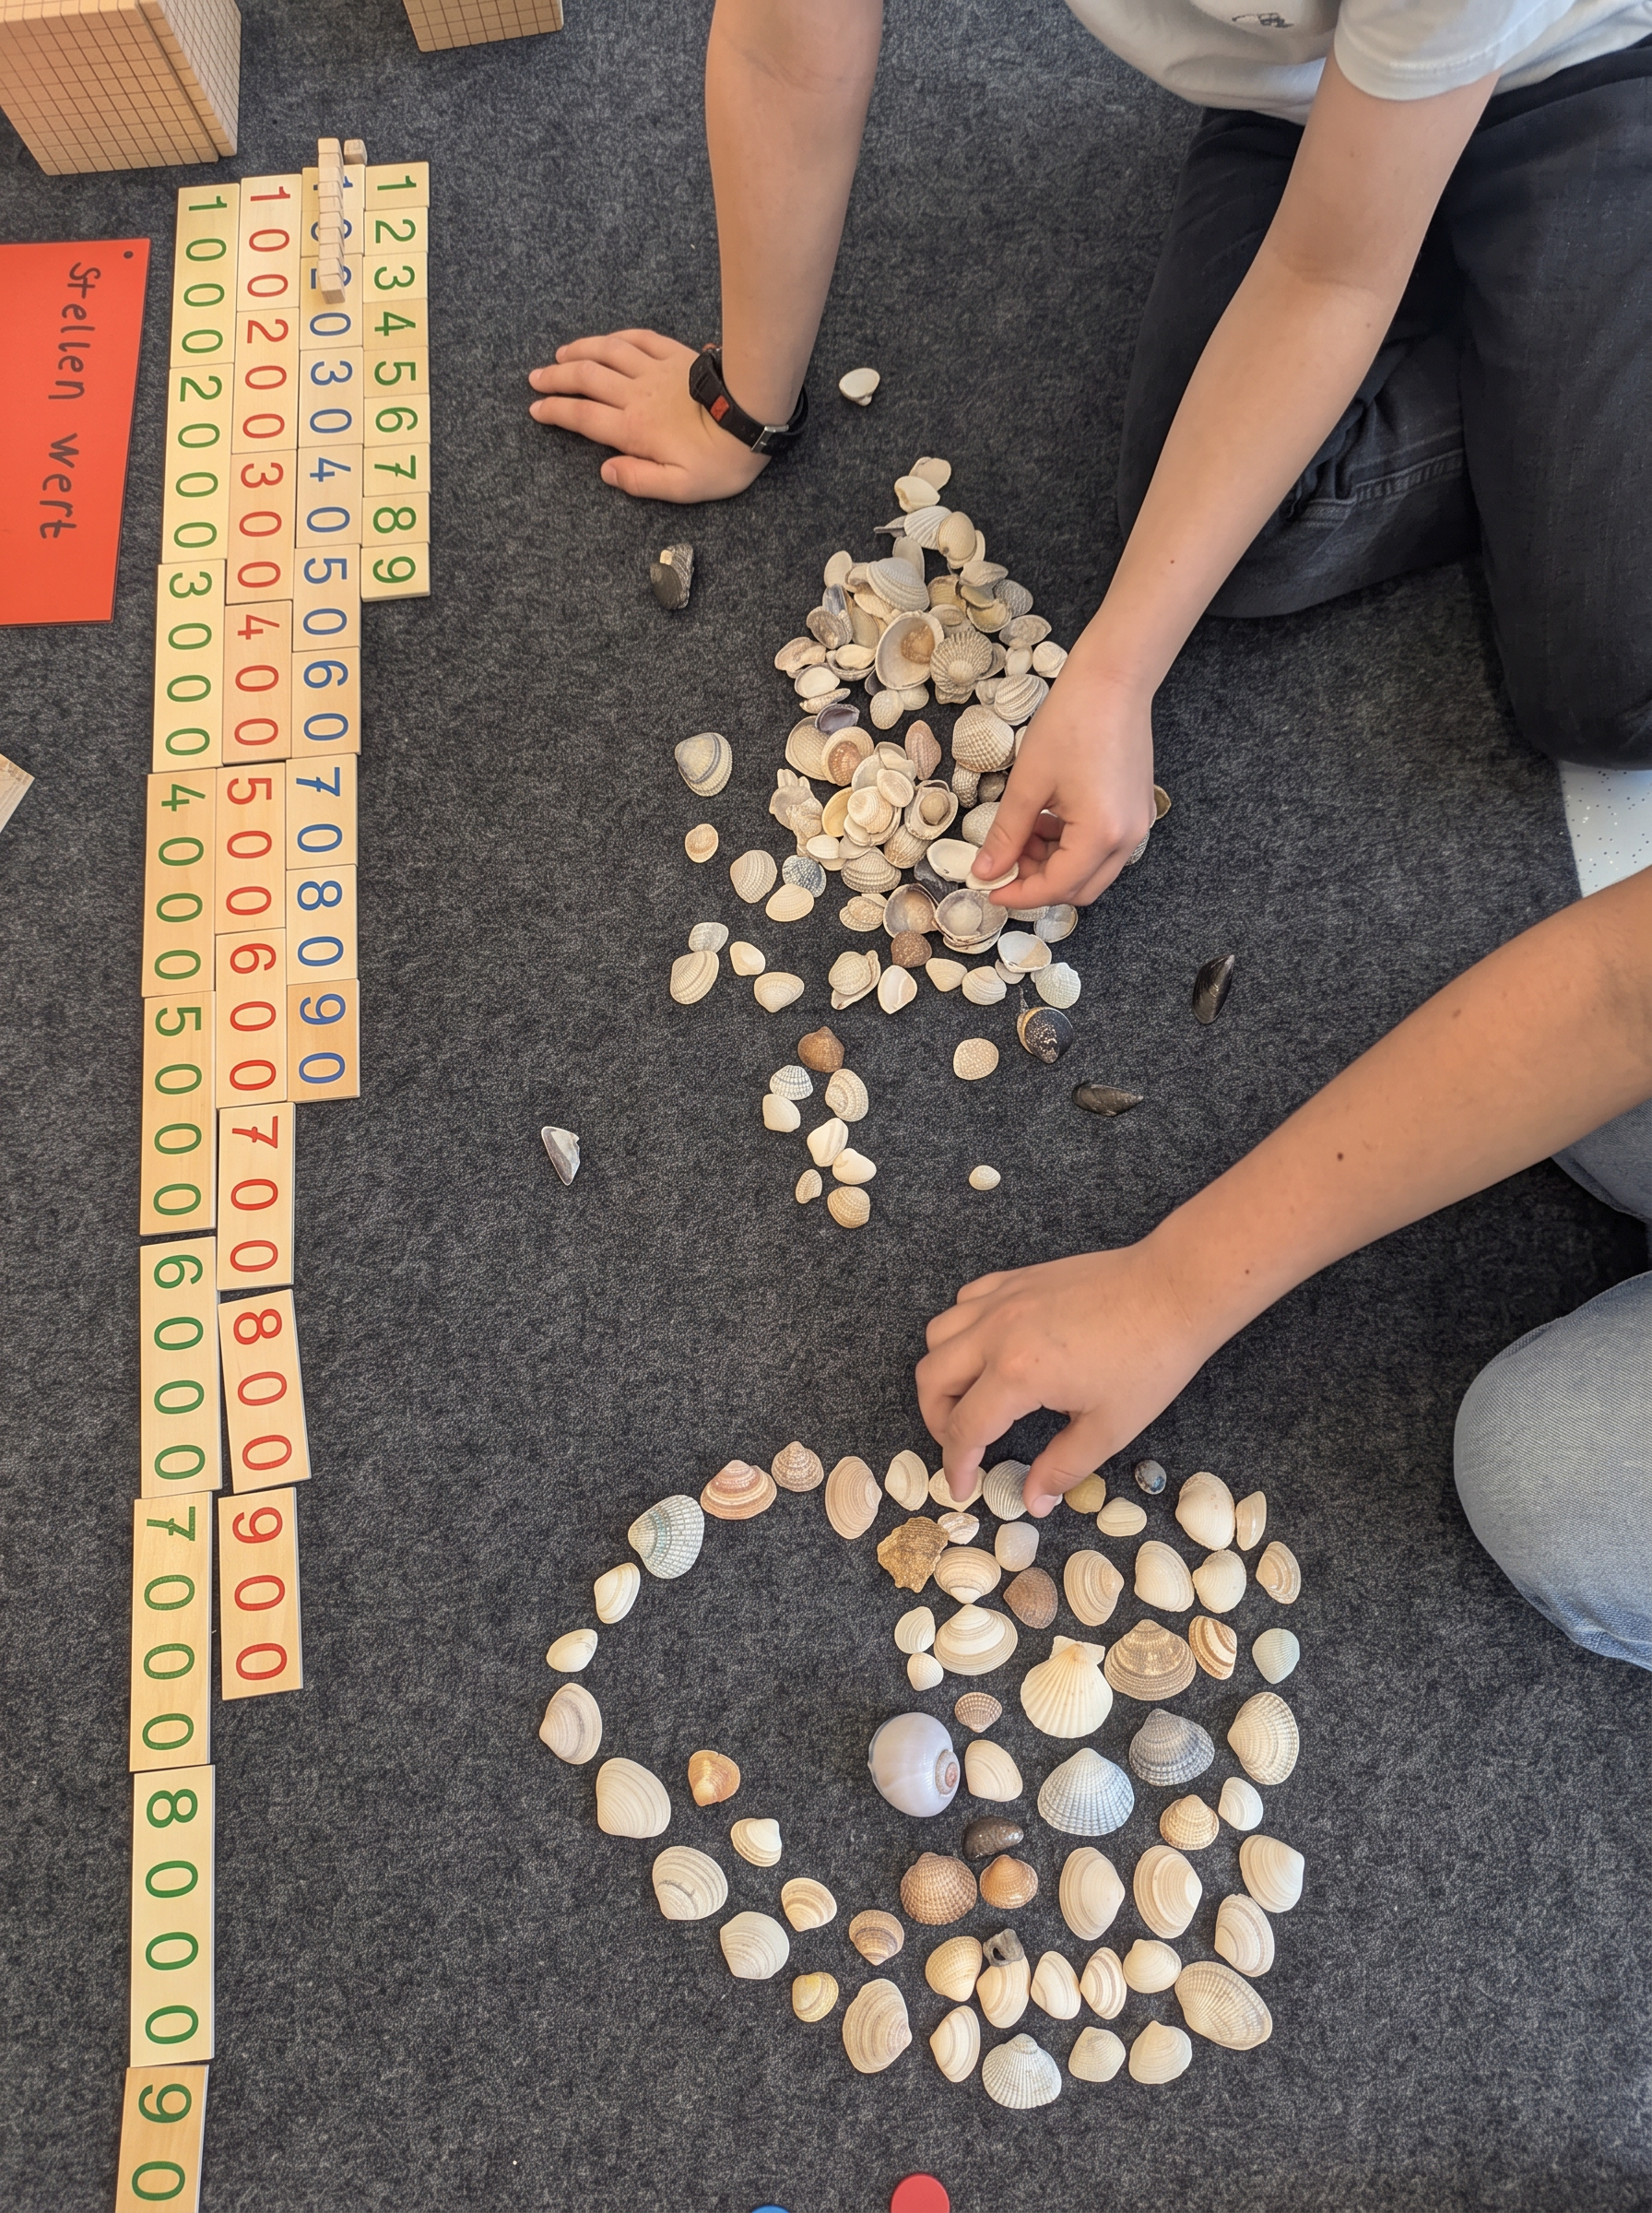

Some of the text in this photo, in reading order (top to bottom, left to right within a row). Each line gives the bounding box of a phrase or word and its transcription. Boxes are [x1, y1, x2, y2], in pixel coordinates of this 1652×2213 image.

[375, 219, 416, 243] 2
[376, 175, 417, 191] 1
[182, 195, 228, 354] 1000
[247, 186, 290, 298] 100
[373, 266, 415, 290] 3
[48, 262, 101, 400] Stellen
[242, 319, 289, 439] 200
[373, 361, 416, 385] 5
[374, 312, 416, 337] 4
[309, 361, 353, 434] 30
[375, 407, 418, 432] 6
[173, 375, 222, 549] 2000
[306, 456, 351, 533] 40
[372, 506, 417, 534] 8
[373, 455, 417, 479] 7
[237, 462, 284, 588] 300
[372, 556, 416, 584] 9
[302, 557, 348, 635] 50
[165, 571, 213, 756] 3000
[234, 614, 280, 746] 400
[303, 659, 348, 740] 60
[226, 777, 272, 916] 500
[296, 766, 341, 853] 70
[154, 783, 206, 980] 4000
[297, 881, 344, 966] 80
[230, 943, 277, 1091] 600
[299, 993, 346, 1083] 90
[153, 1006, 202, 1216] 5000
[230, 1116, 278, 1272] 700
[153, 1254, 206, 1480] 6000
[233, 1308, 292, 1471] 800
[142, 1506, 196, 1751] 7000
[231, 1507, 288, 1681] 900
[145, 1788, 199, 2045] 8000
